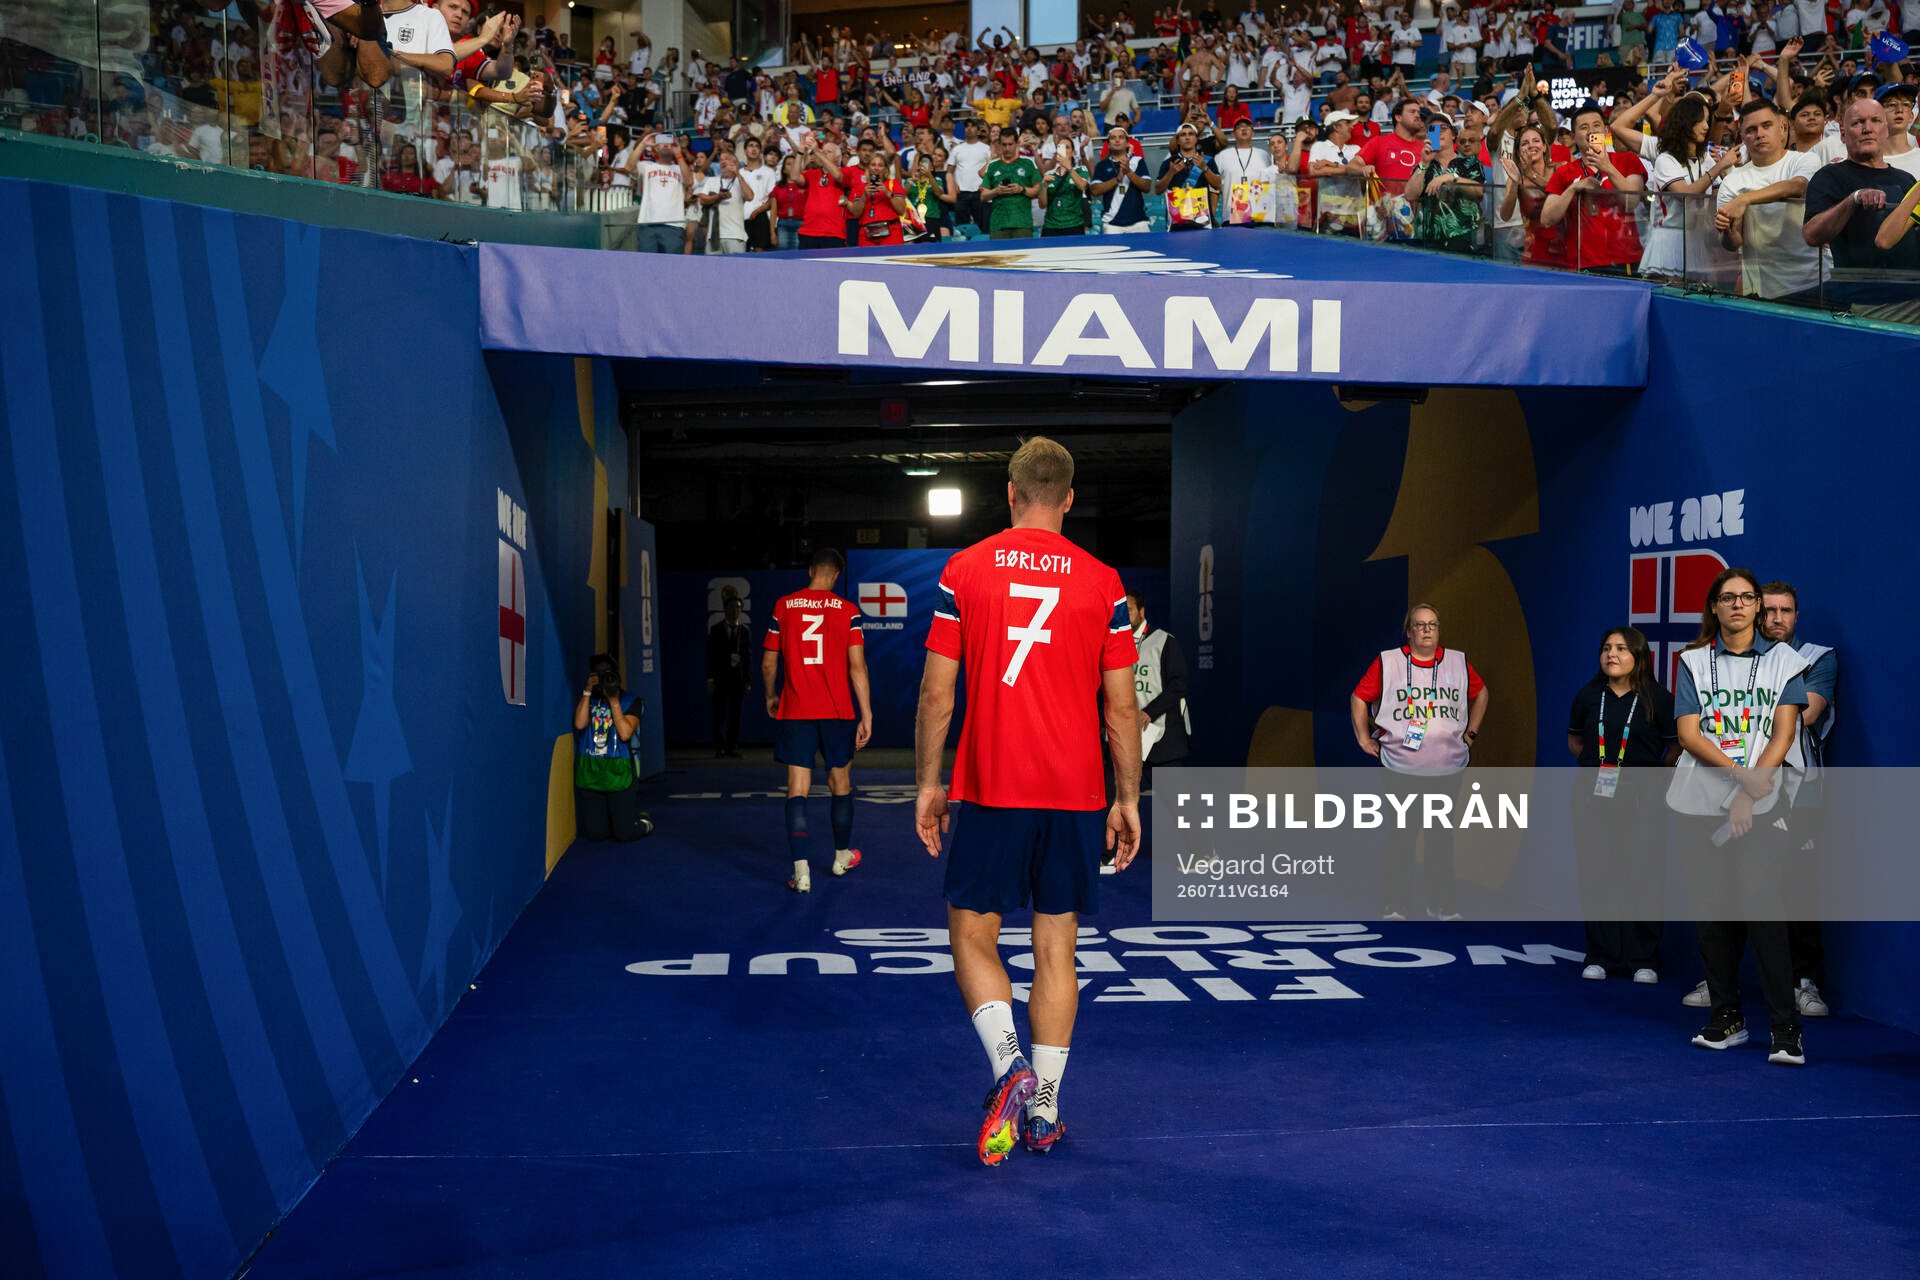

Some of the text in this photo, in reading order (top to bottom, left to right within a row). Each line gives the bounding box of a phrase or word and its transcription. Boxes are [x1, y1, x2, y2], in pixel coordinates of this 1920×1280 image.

[1551, 78, 1576, 89] FIFA
[1551, 98, 1575, 109] CUP
[838, 280, 1342, 373] MIAMI
[1629, 488, 1745, 547] WE ARE
[995, 549, 1071, 574] SØRLOTH
[786, 598, 843, 609] VASSBAKK AJER
[863, 622, 904, 630] ENGLAND
[1001, 582, 1060, 688] 7
[802, 614, 824, 665] 3
[625, 951, 955, 976] CUP
